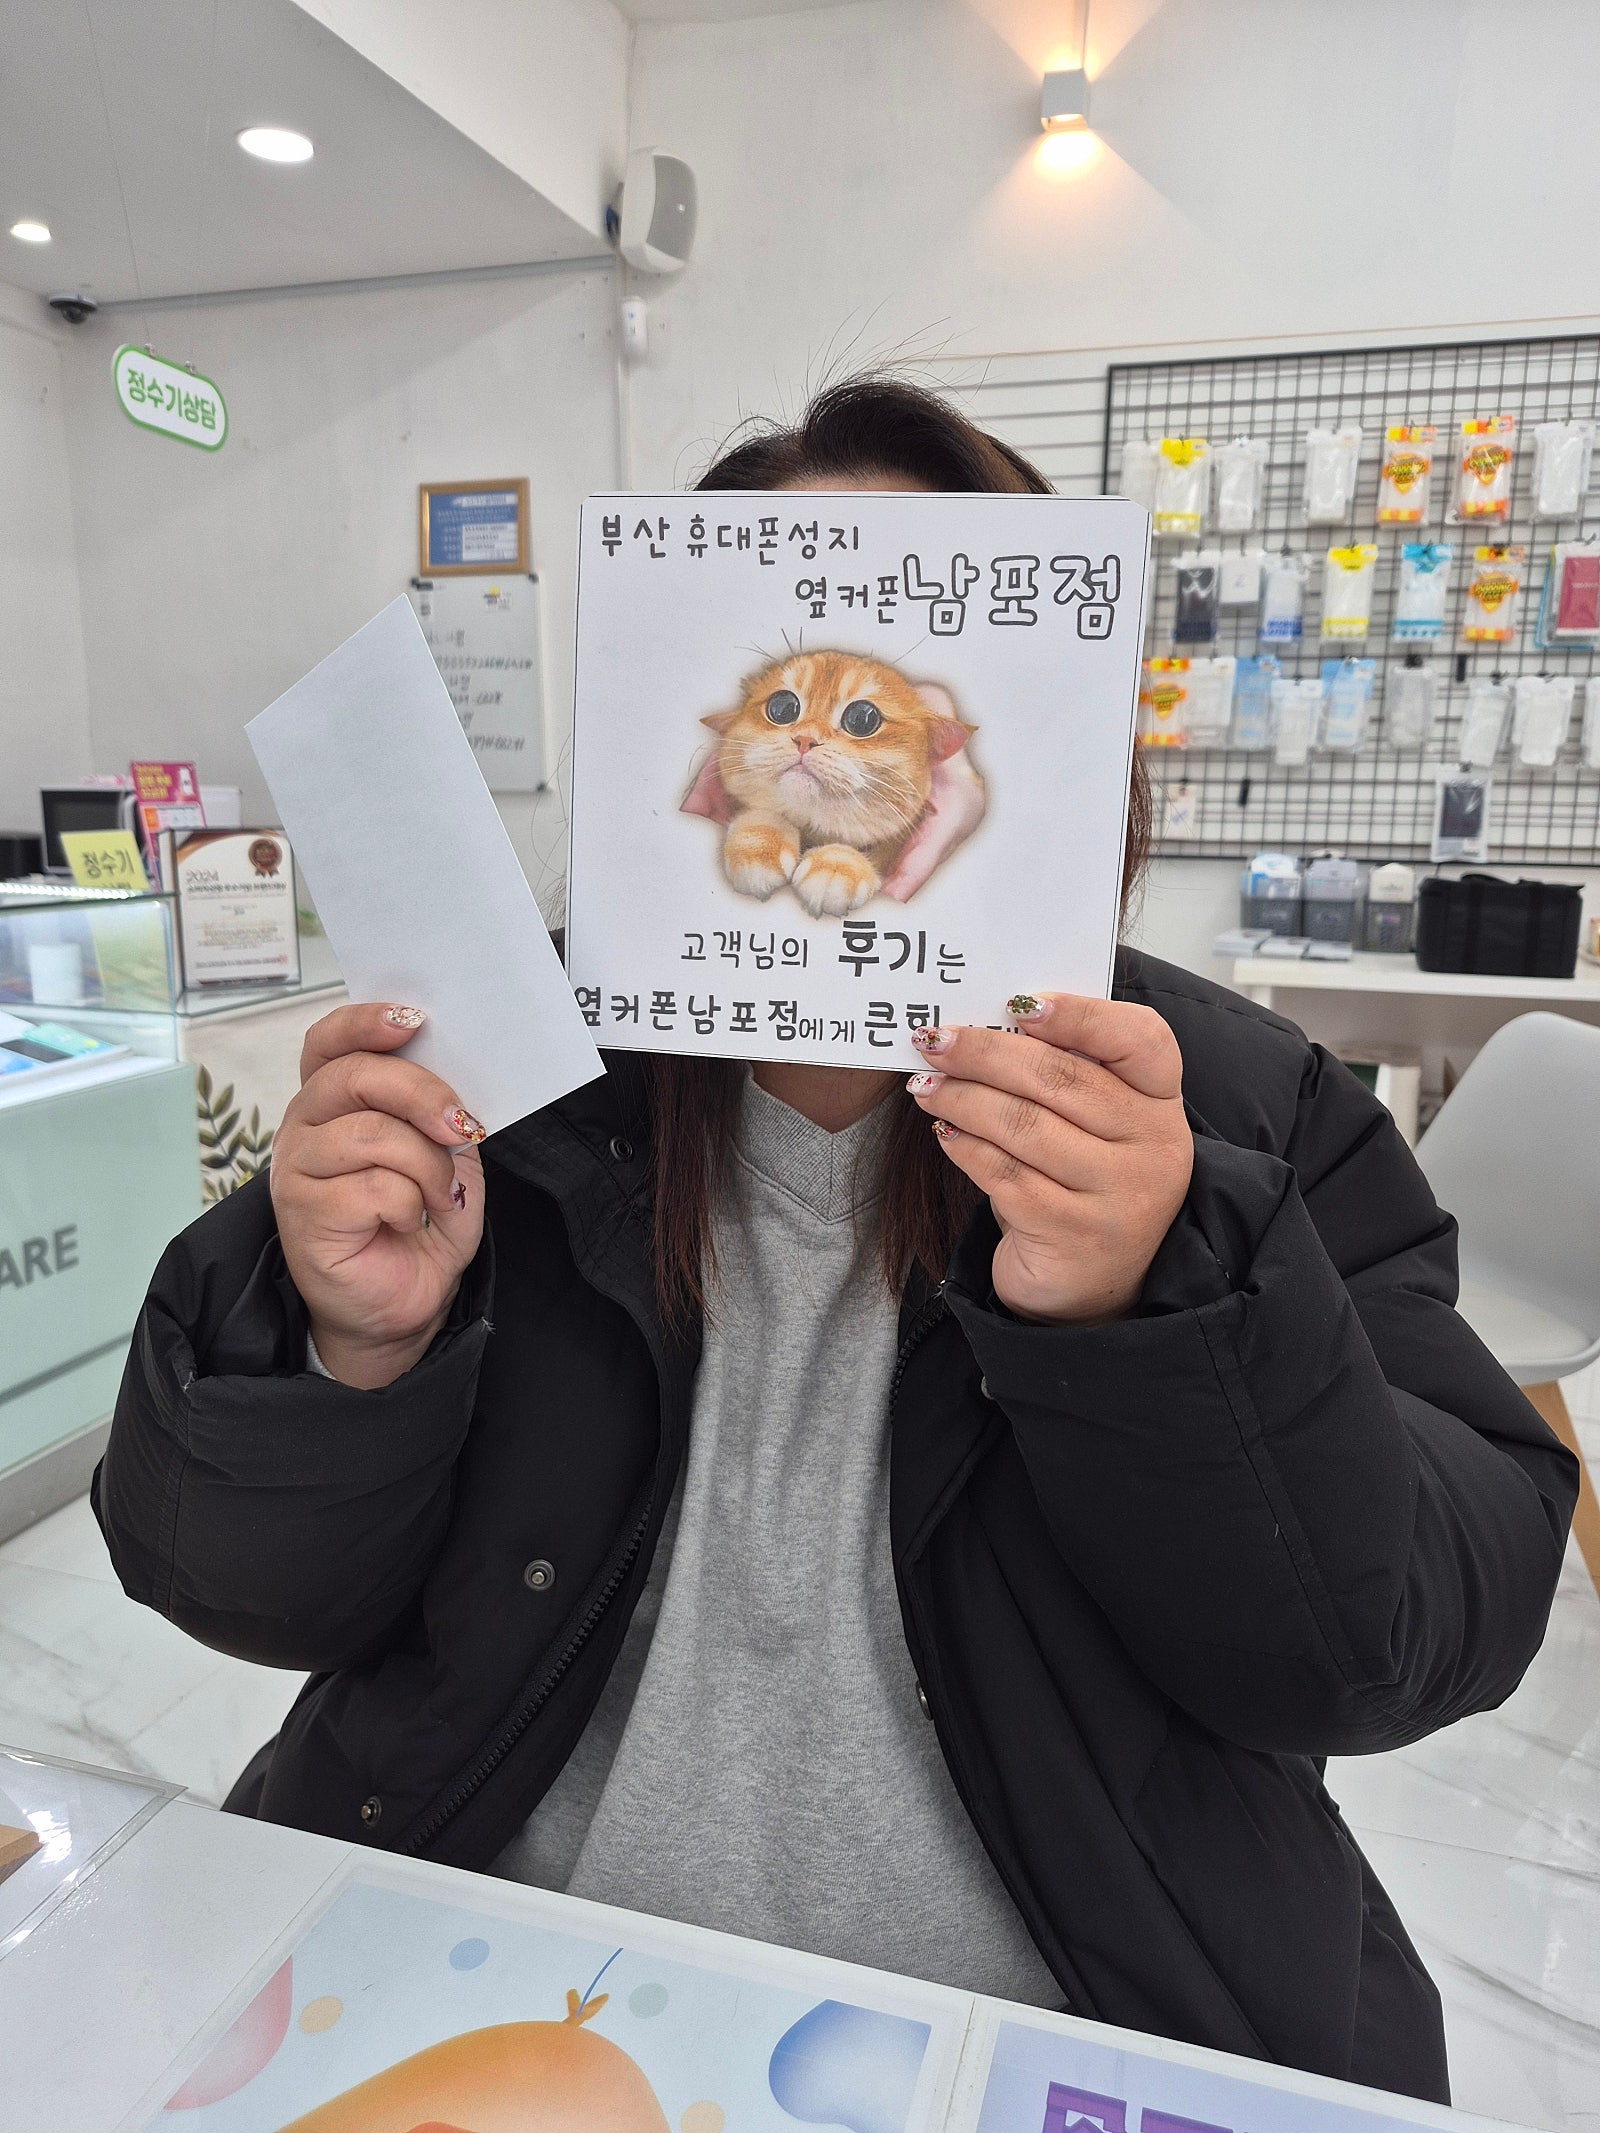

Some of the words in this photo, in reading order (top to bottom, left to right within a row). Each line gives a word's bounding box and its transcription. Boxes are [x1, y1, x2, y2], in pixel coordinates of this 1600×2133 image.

[127, 368, 216, 430] 정수기상담
[601, 514, 670, 559] 부산
[687, 514, 859, 565] 휴대폰성지
[82, 850, 135, 878] 정수기
[681, 930, 808, 970] 고객님의
[838, 920, 966, 984] 후기는
